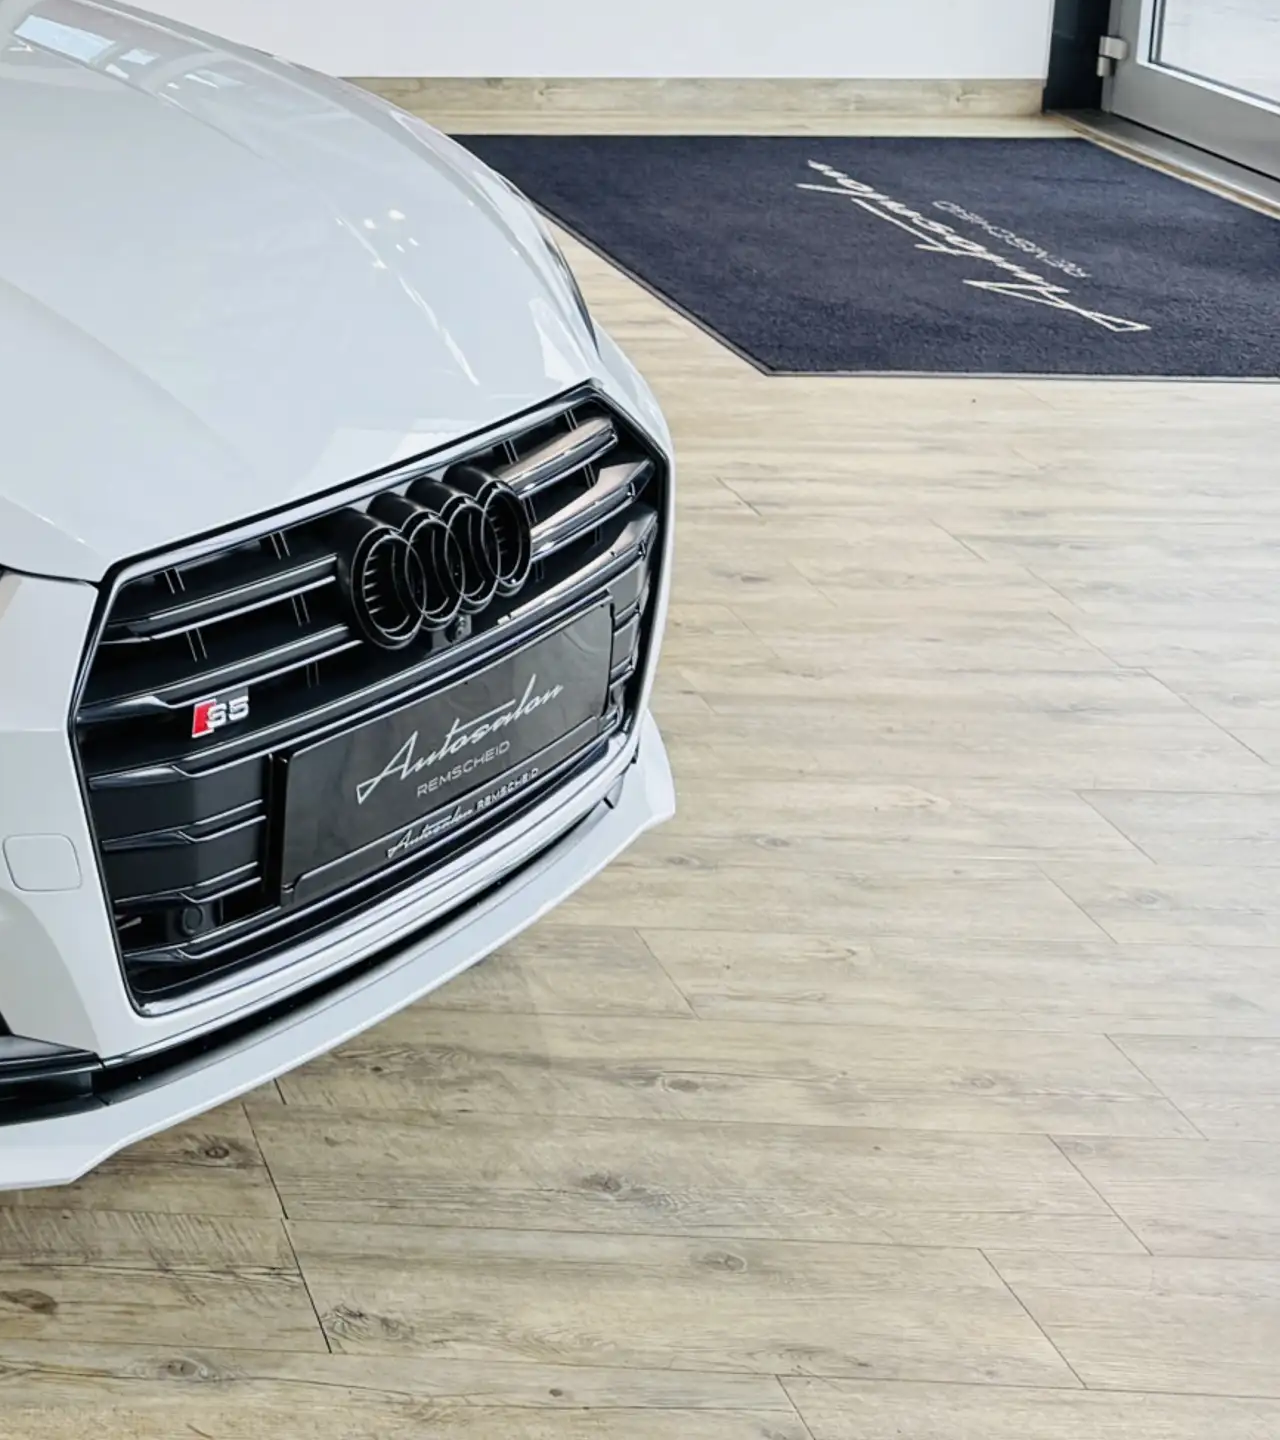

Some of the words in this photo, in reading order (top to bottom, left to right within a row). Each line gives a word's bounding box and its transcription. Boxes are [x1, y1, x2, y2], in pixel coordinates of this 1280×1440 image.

[795, 160, 1151, 332] Autosalon
[205, 695, 249, 730] S5
[356, 673, 564, 805] Autosalon
[387, 806, 474, 858] Autosalon
[476, 768, 539, 811] REMSCHEID
[416, 741, 511, 797] REMSCHEID
